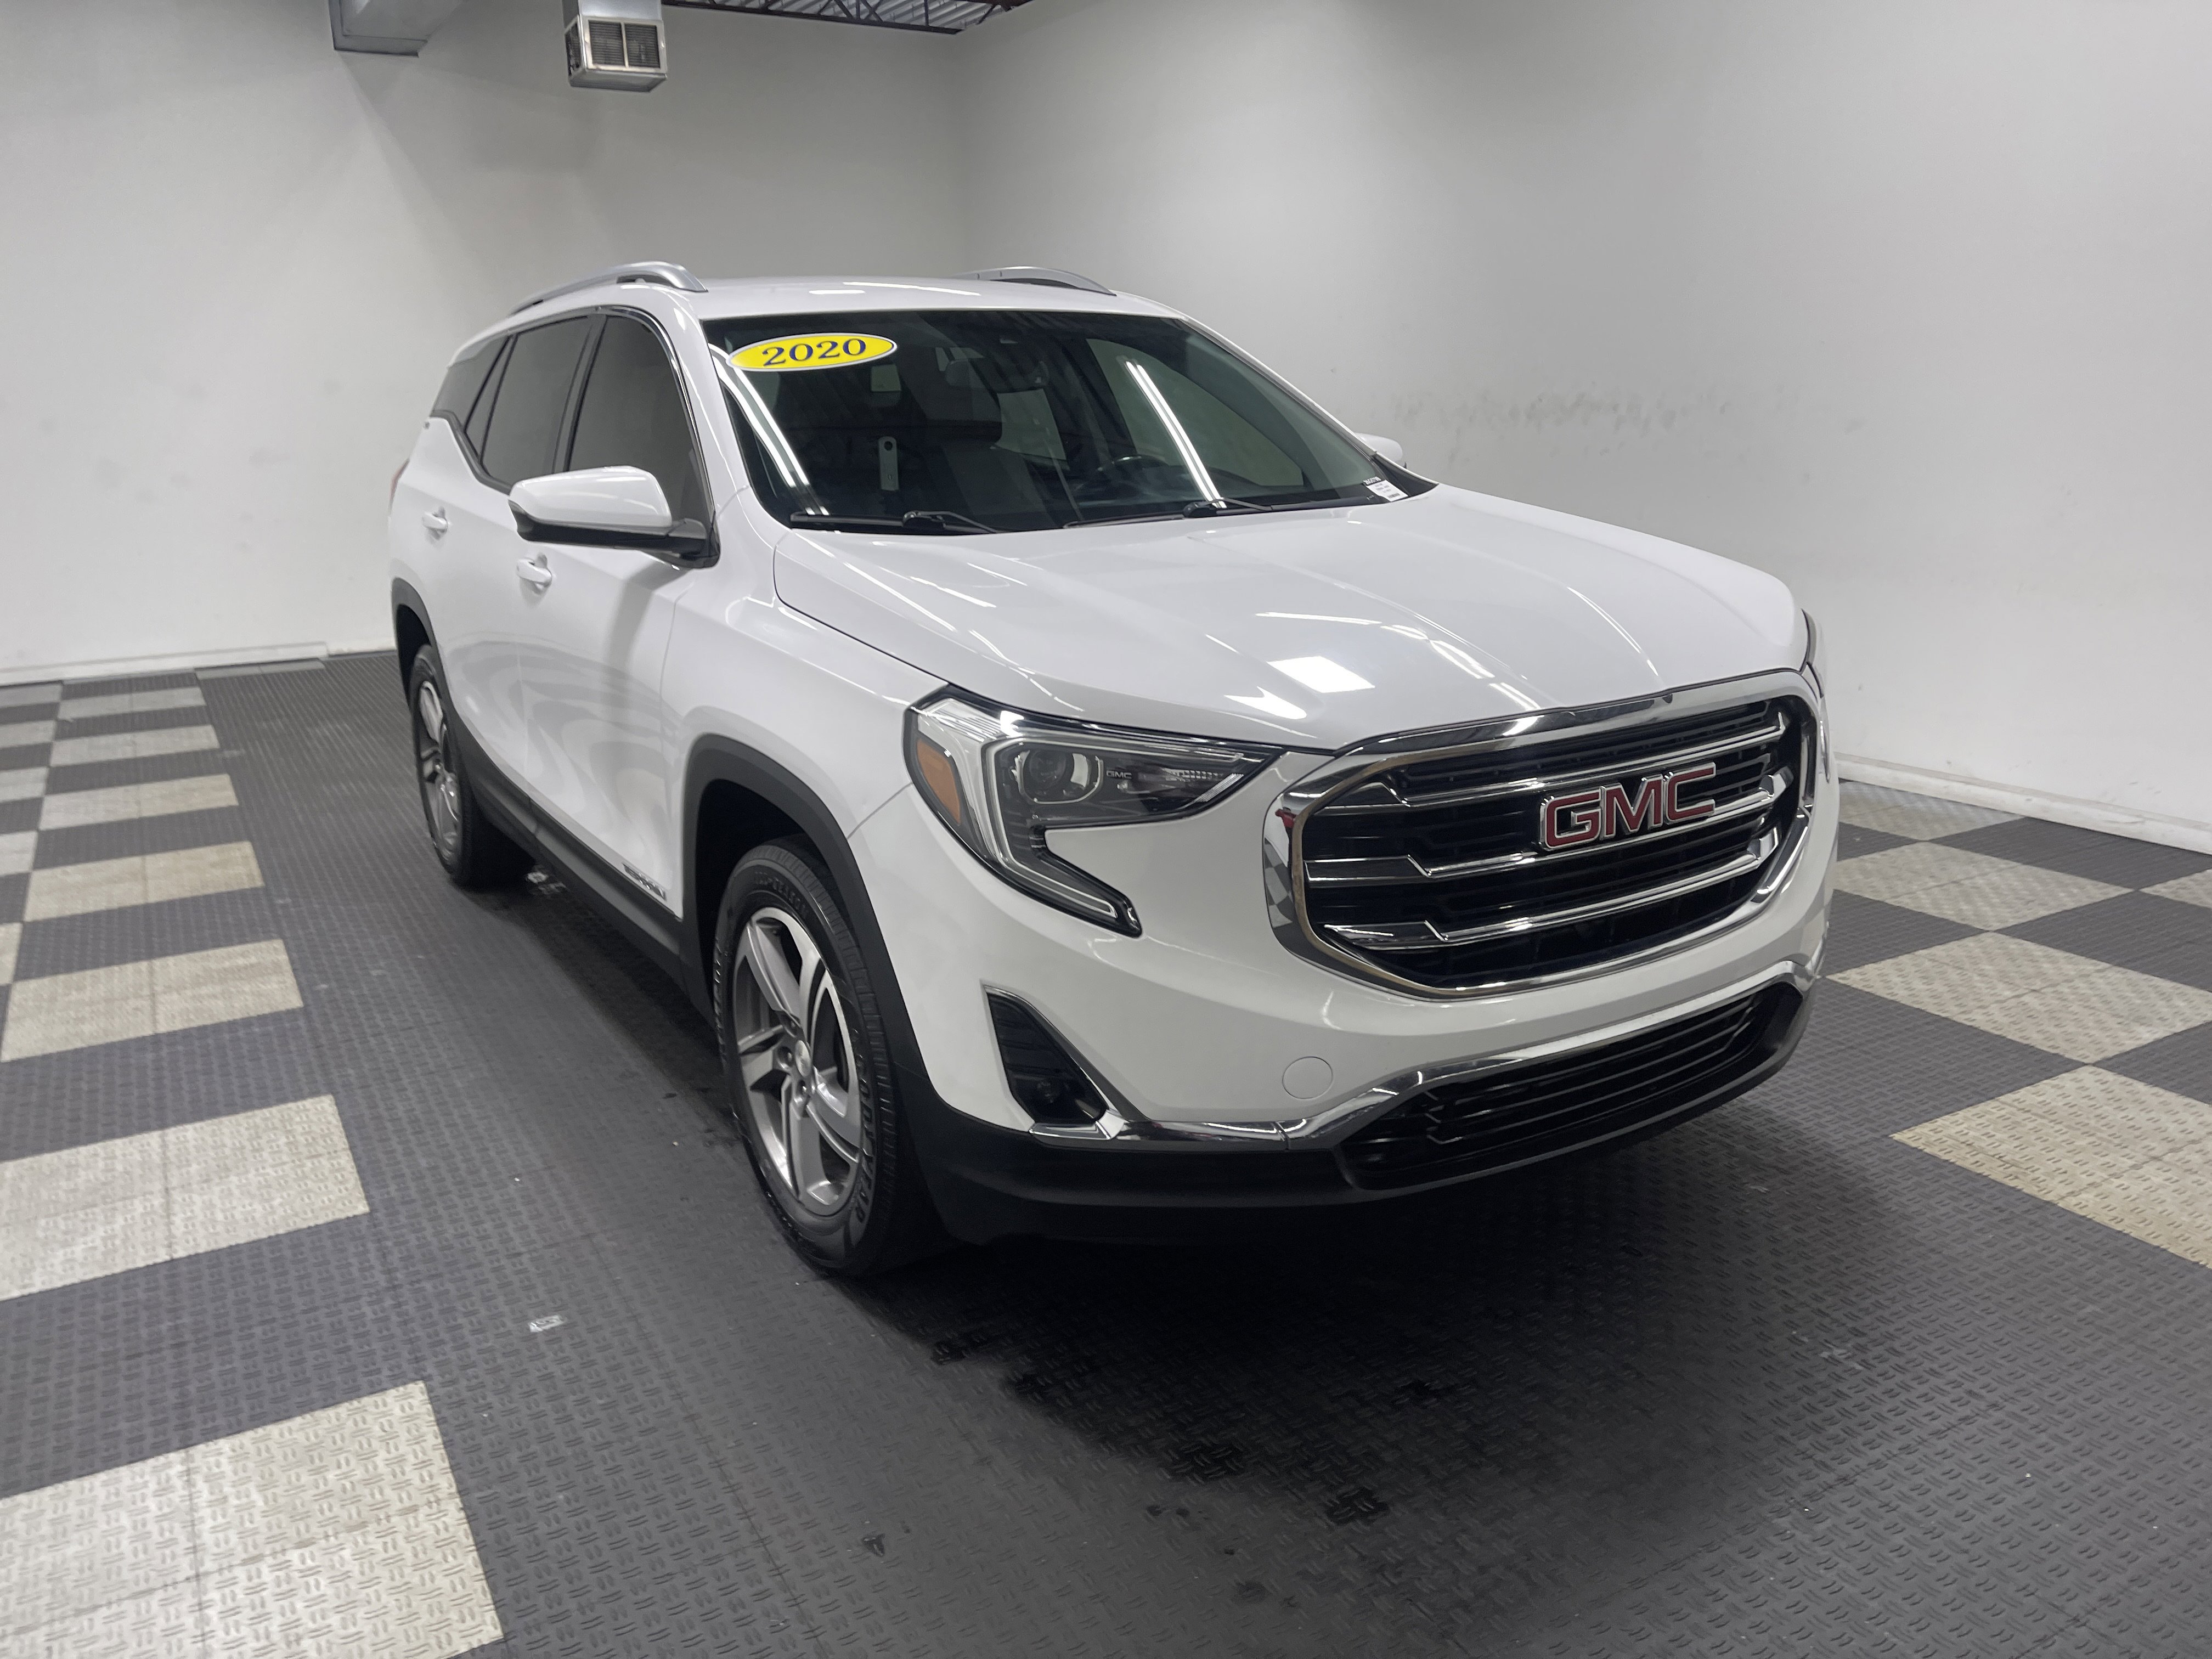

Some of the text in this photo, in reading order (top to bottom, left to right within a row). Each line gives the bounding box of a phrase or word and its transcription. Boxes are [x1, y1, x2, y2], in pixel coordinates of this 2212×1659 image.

[762, 338, 866, 366] 2020
[1106, 770, 1132, 779] GMC
[1539, 761, 1717, 851] GMC
